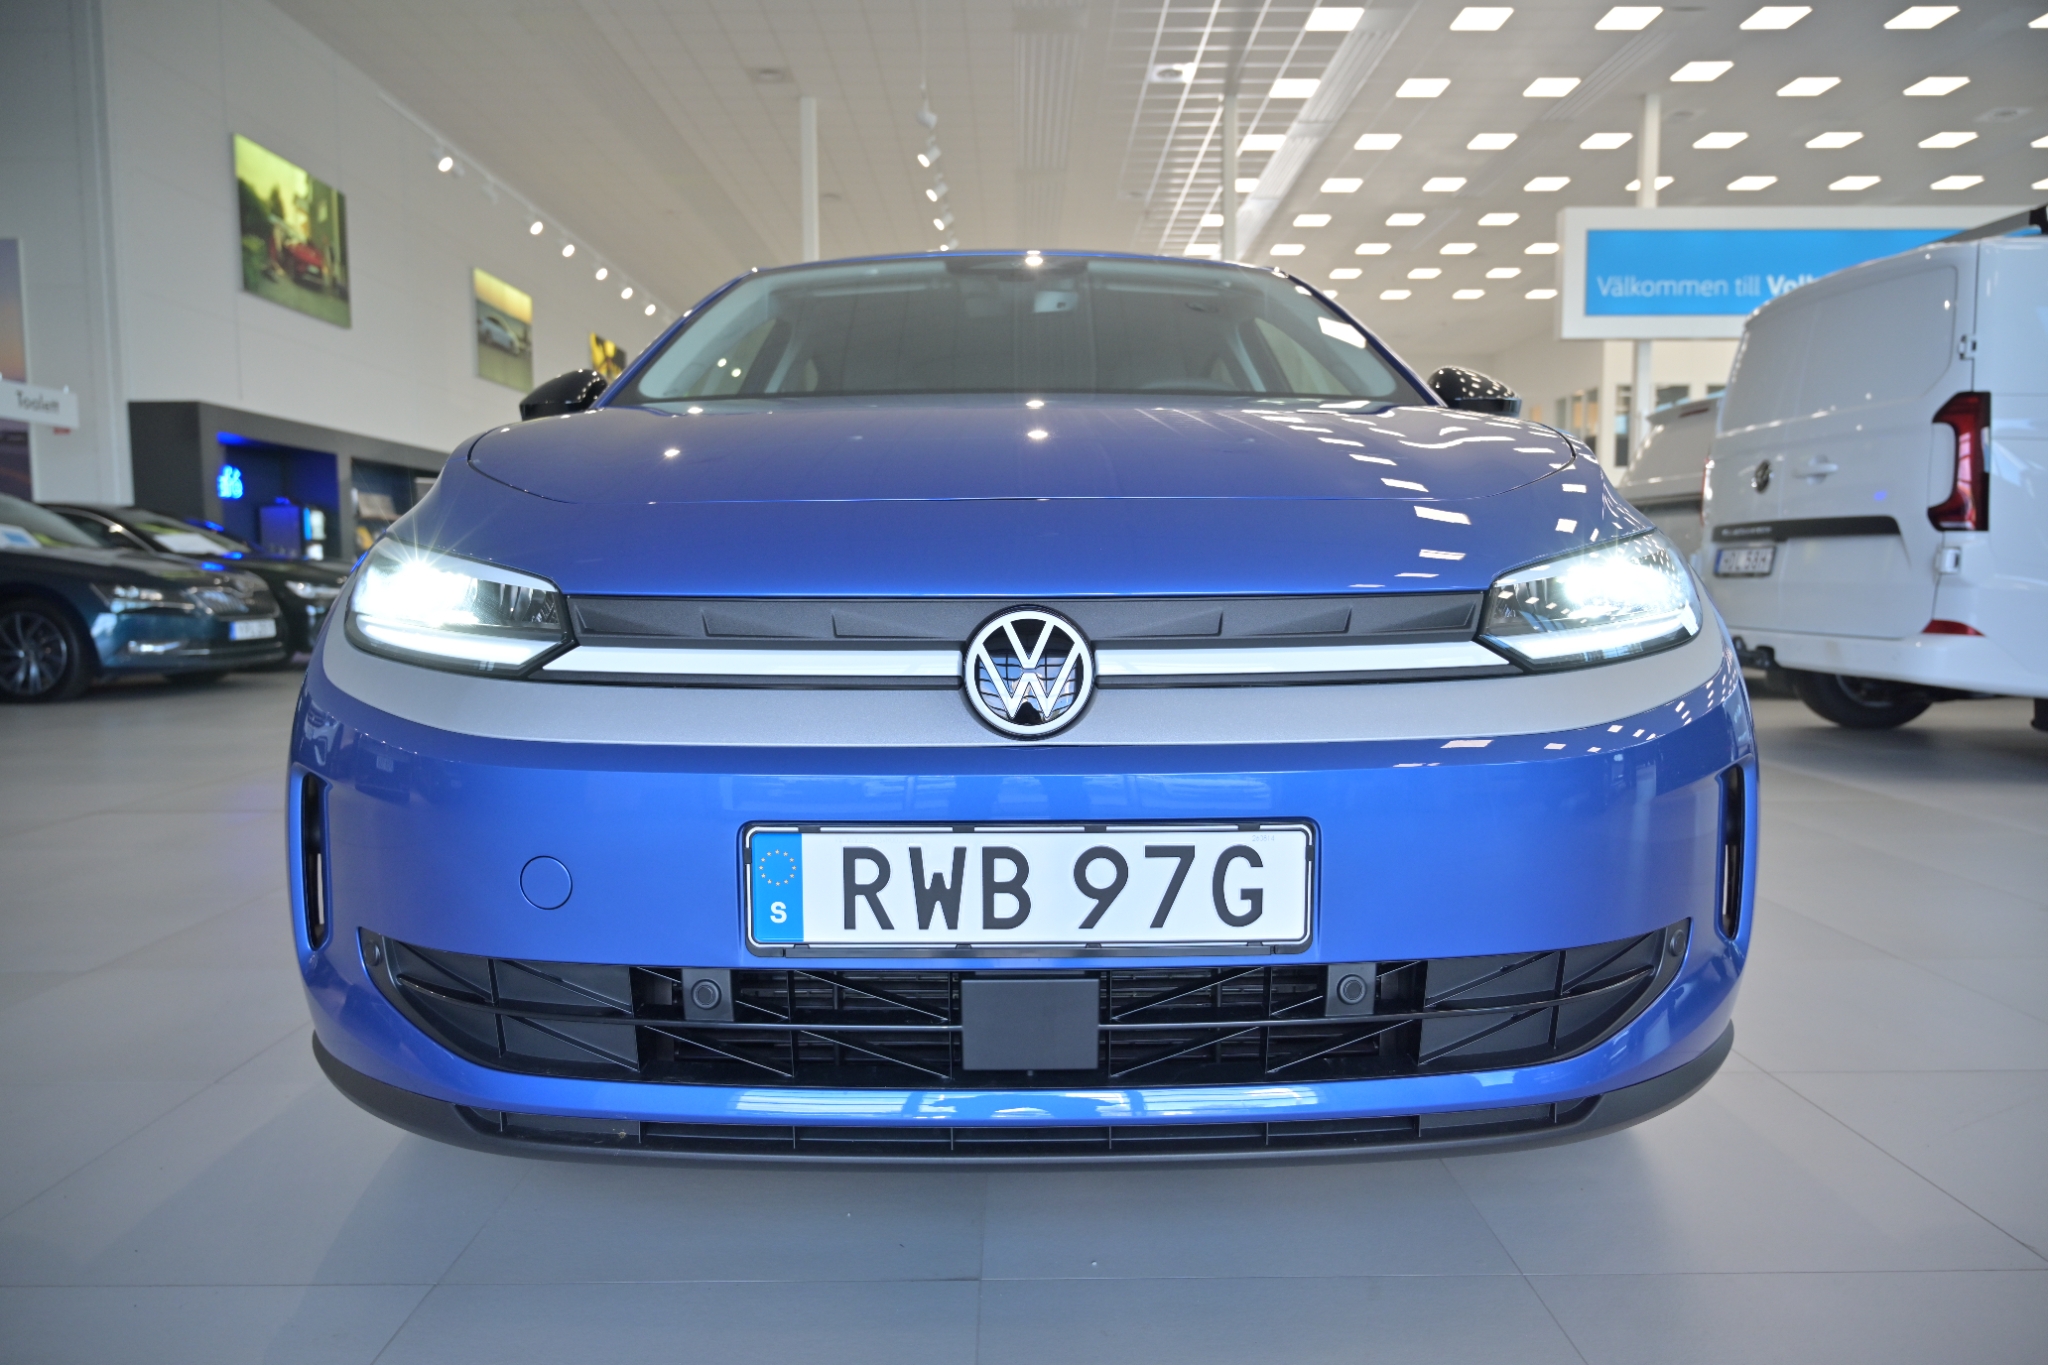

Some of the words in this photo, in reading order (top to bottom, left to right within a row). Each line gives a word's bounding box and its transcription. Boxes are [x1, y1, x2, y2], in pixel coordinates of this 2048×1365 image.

[1597, 275, 1728, 298] Välkommen
[1735, 275, 1761, 297] till
[843, 847, 1031, 930] RWB
[1073, 844, 1264, 929] 97G
[769, 901, 787, 924] S
